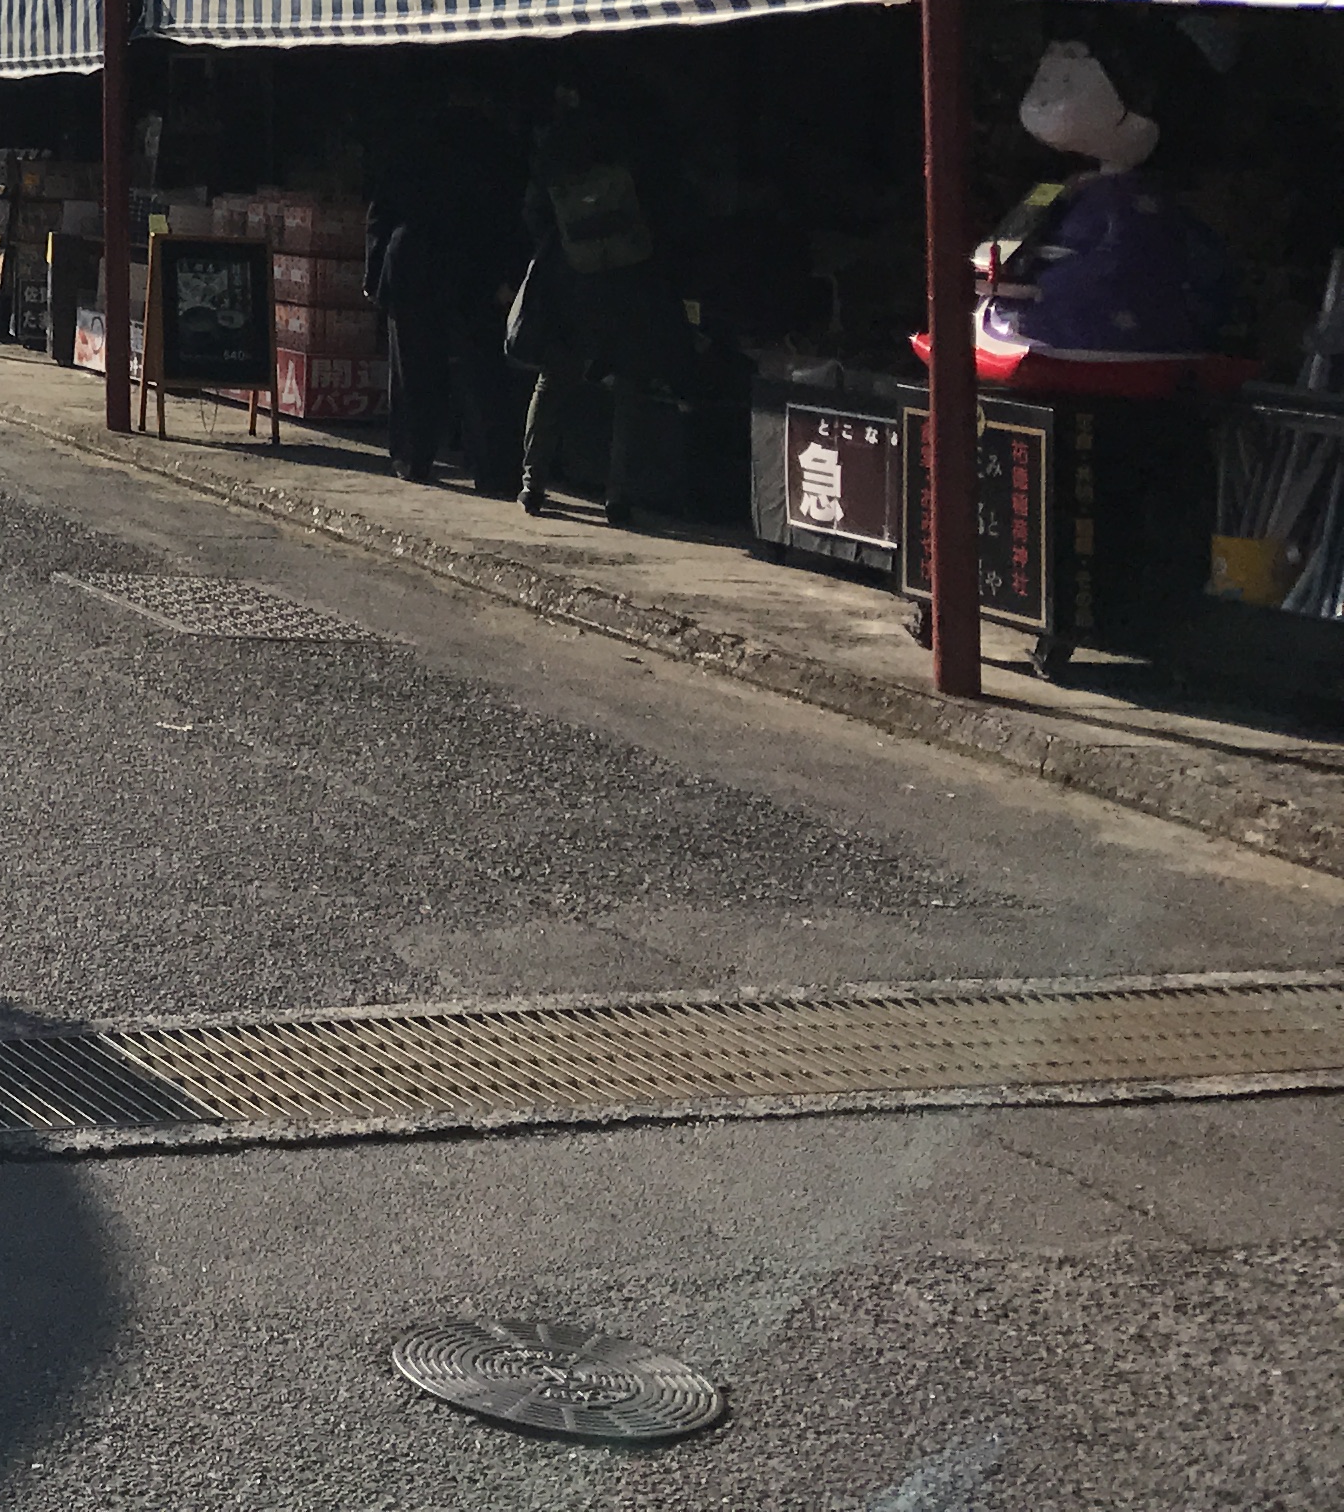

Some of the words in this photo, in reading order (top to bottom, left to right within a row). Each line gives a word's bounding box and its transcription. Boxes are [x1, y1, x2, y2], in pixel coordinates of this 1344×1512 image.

[310, 358, 390, 389] 開運
[797, 441, 846, 522] 急
[984, 453, 1004, 597] みとや
